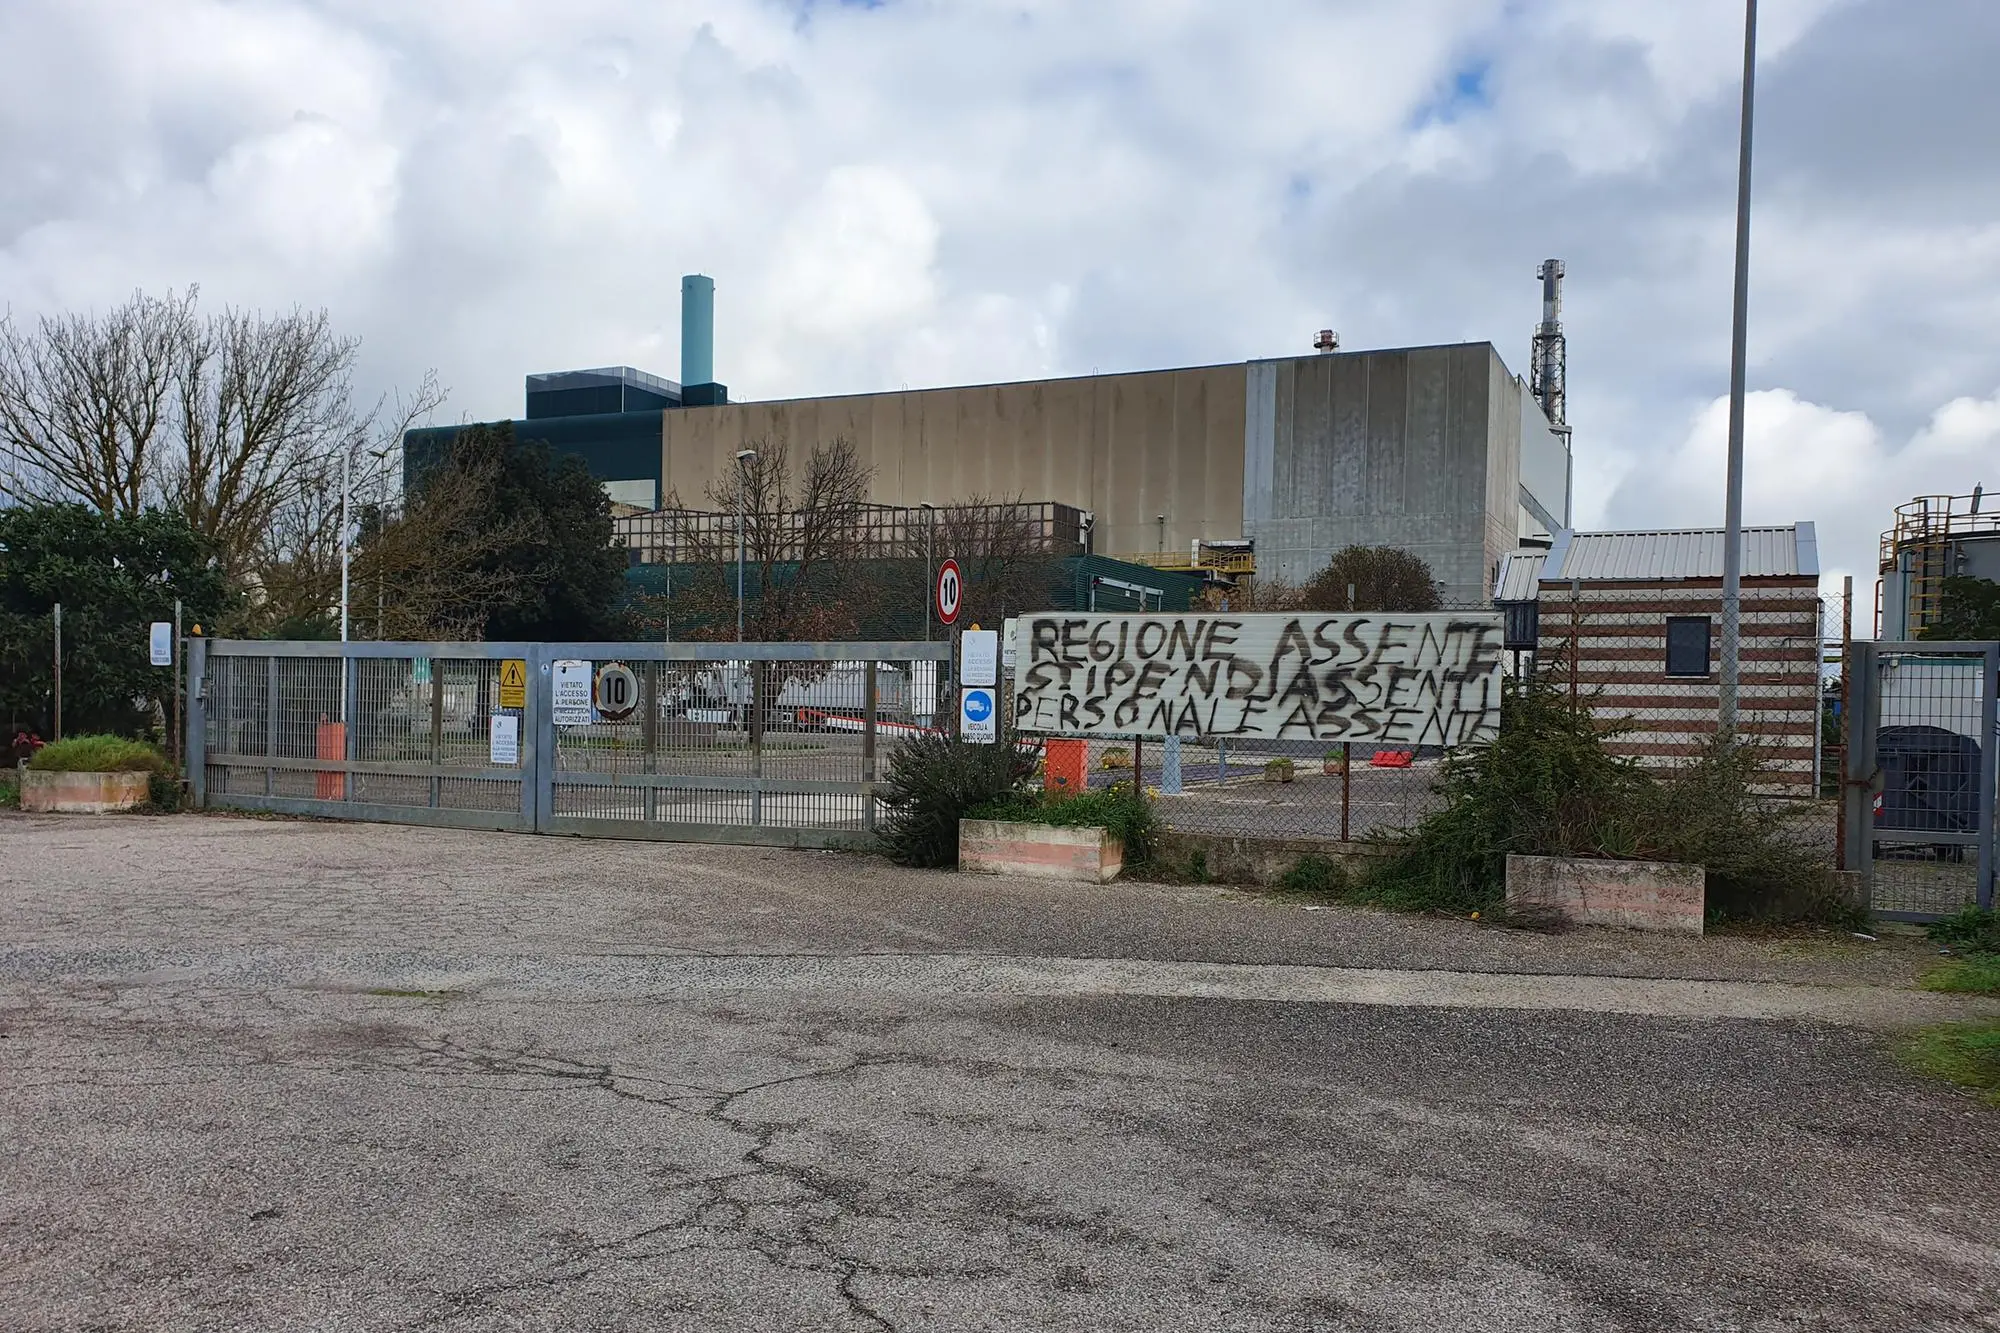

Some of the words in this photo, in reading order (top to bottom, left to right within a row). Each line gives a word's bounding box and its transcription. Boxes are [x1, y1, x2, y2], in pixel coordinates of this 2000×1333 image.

[944, 577, 956, 606] 10
[1031, 618, 1243, 663] REGIONE
[1270, 618, 1502, 672] ASSENTE
[606, 677, 626, 704] 10
[1022, 658, 1278, 700] STIPENDI
[1277, 664, 1490, 709] ASSENTI
[1015, 692, 1270, 735] PERSONALE
[1276, 700, 1500, 748] ASSENTE
